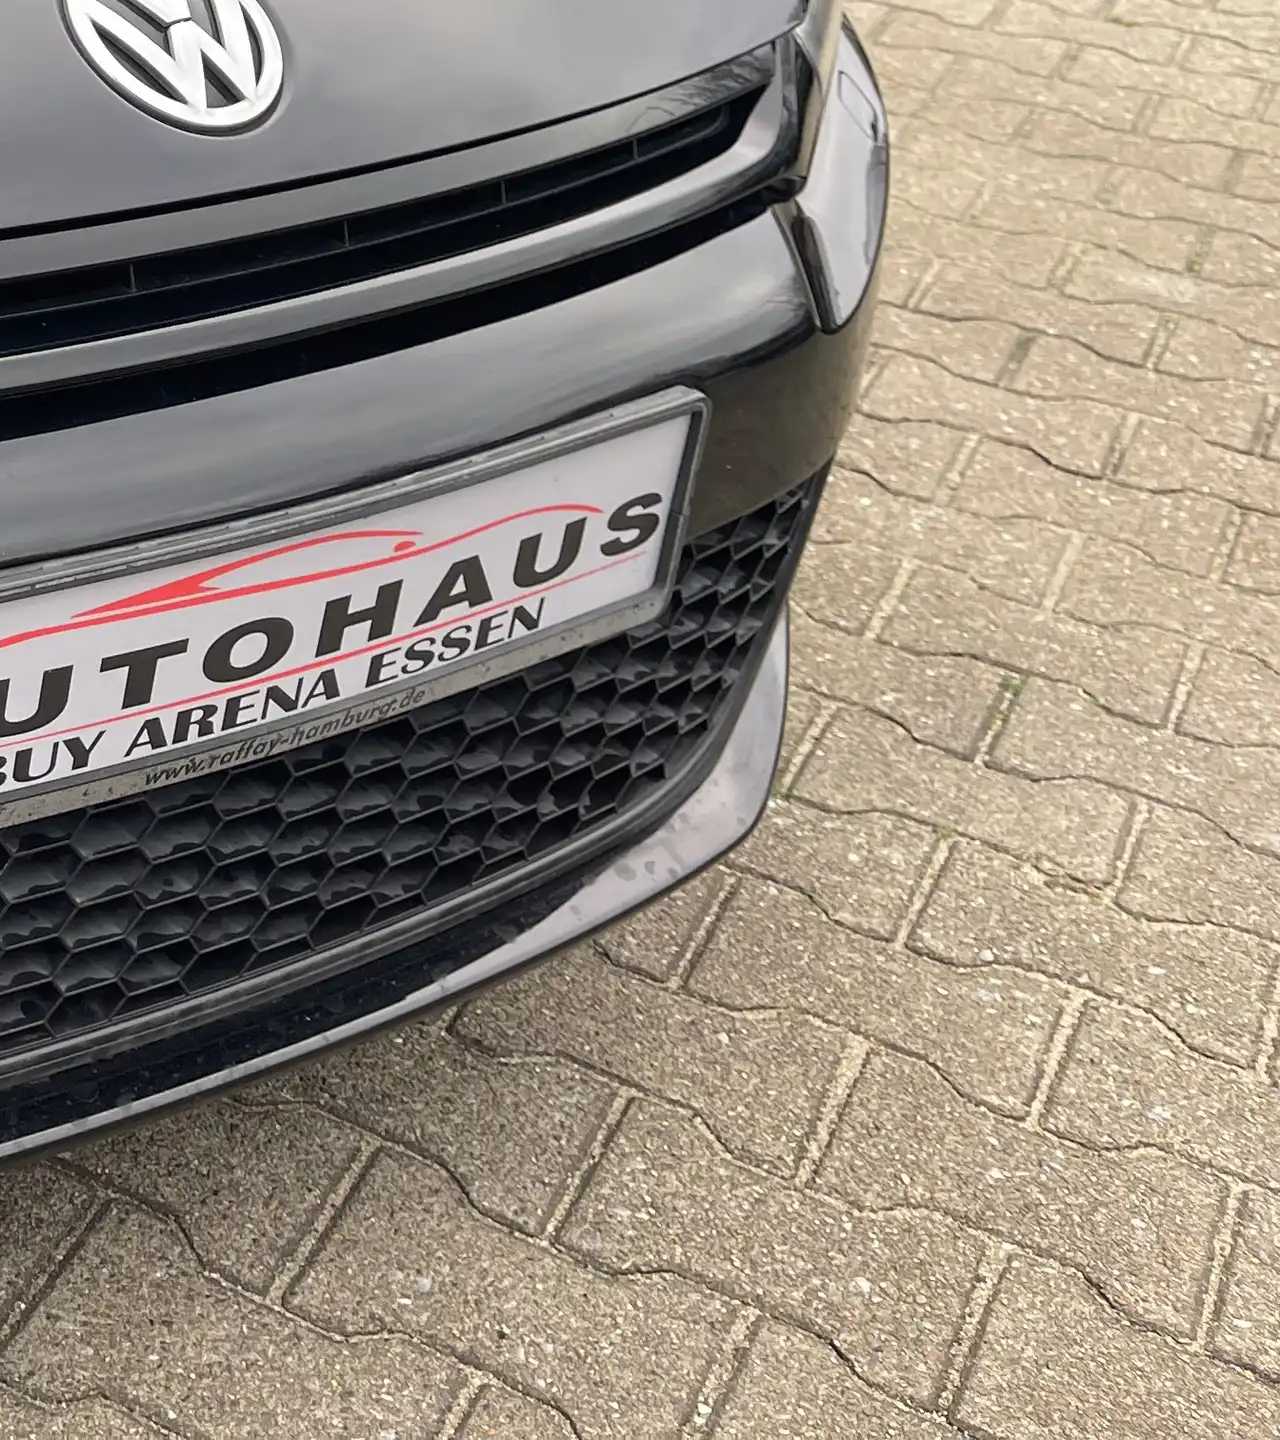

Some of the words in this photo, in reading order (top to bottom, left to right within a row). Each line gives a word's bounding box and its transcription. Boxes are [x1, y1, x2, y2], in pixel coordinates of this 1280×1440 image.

[123, 668, 341, 758] ARENA
[365, 597, 545, 689] ESSEN
[144, 686, 425, 786] www.raffay-hamburg.de
